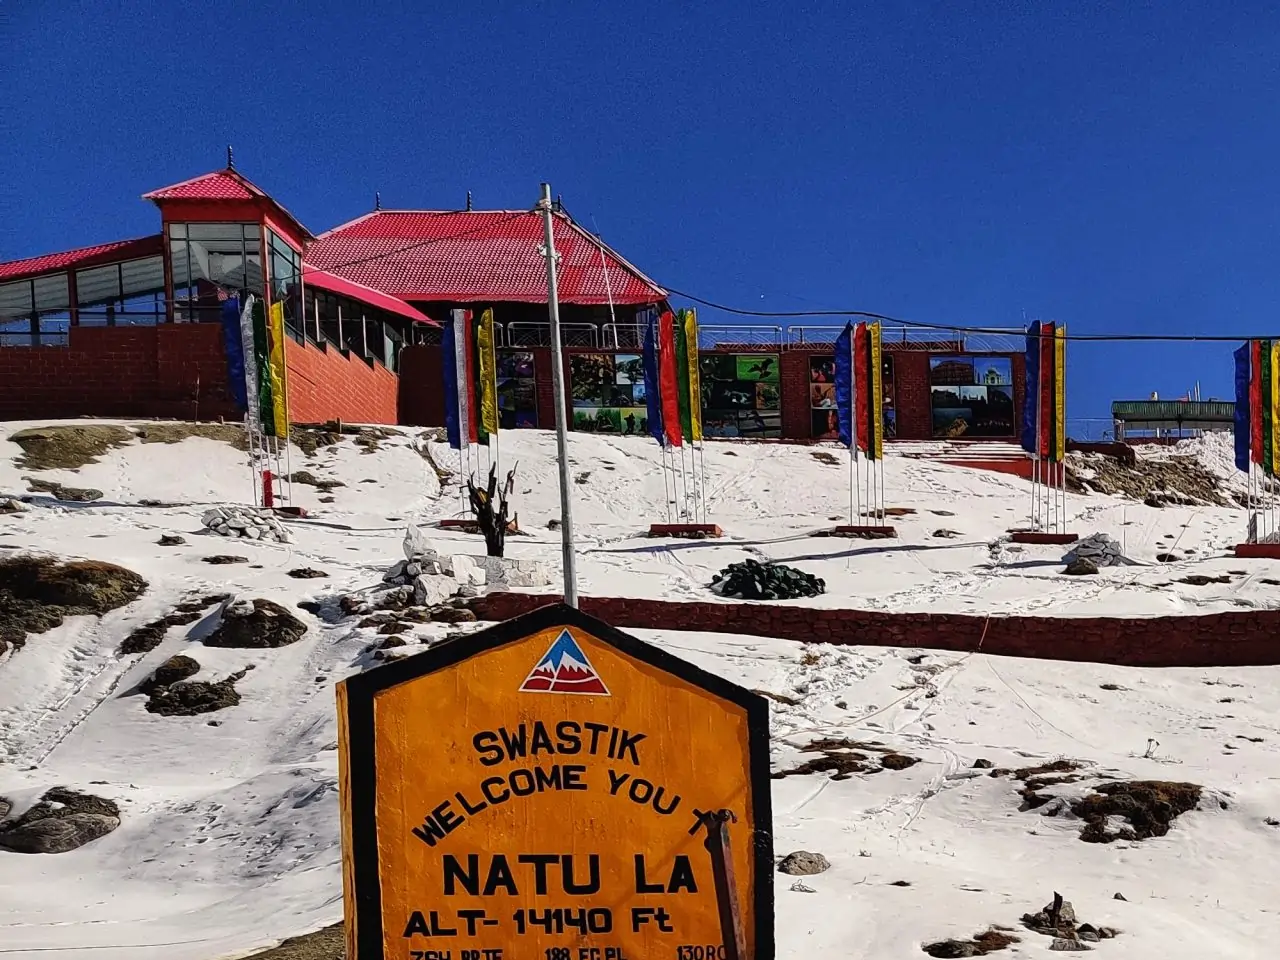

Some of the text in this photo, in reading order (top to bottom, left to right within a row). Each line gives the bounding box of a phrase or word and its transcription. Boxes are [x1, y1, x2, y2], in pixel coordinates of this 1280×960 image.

[472, 721, 647, 766] SWASTIK
[411, 765, 588, 848] WELCOME
[608, 769, 681, 815] YOU
[443, 854, 699, 896] NATU LA
[403, 907, 674, 938] ALT- 14140 Ft
